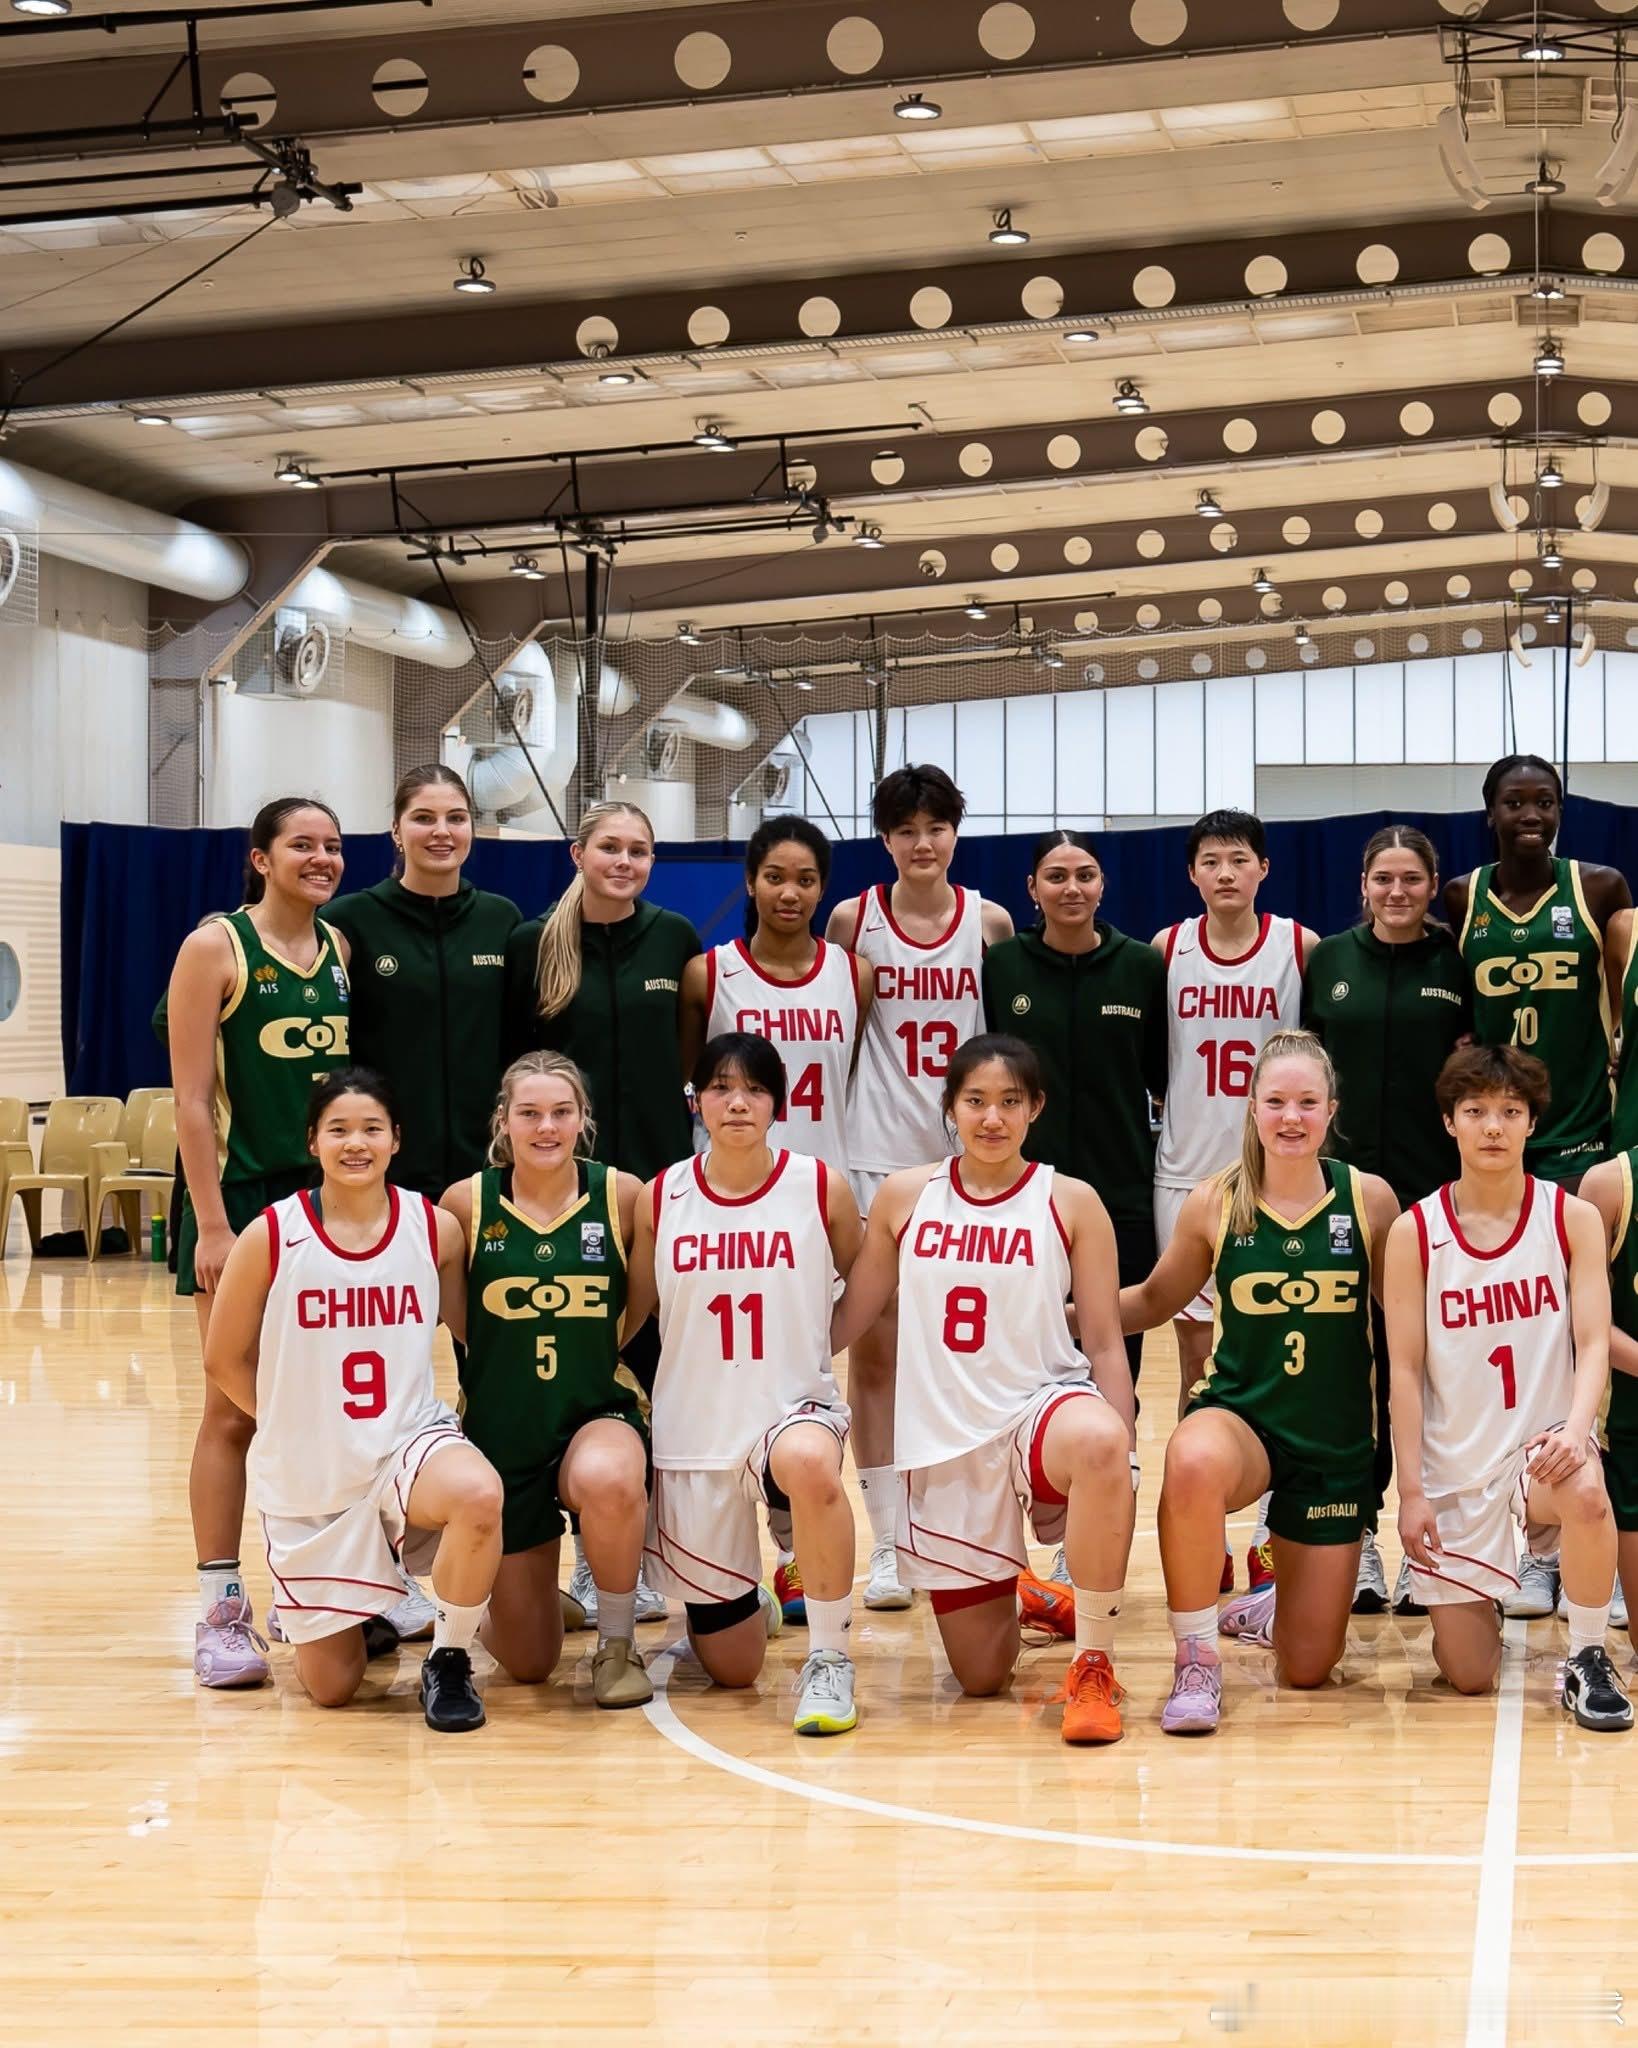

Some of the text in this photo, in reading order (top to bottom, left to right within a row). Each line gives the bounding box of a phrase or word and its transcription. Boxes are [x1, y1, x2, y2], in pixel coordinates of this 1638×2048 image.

[259, 983, 279, 994] AIS
[874, 966, 979, 1000] CHINA
[1178, 985, 1280, 1020] CHINA
[1421, 987, 1461, 1005] AUSTRALIA
[736, 1008, 844, 1043] CHINA
[1101, 1005, 1141, 1019] AUSTRALIA
[1510, 1006, 1538, 1046] 10
[896, 1020, 958, 1077] 13
[1196, 1040, 1256, 1097] 16
[484, 1240, 505, 1252] AIS
[673, 1231, 795, 1273] CHINA
[914, 1221, 1034, 1266] CHINA
[1234, 1236, 1254, 1248] AIS
[297, 1285, 423, 1329] CHINA
[943, 1286, 987, 1353] 8
[1440, 1274, 1560, 1328] CHINA
[707, 1293, 763, 1360] 11
[536, 1335, 558, 1380] 5
[1284, 1331, 1306, 1376] 3
[342, 1351, 387, 1419] 9
[1487, 1345, 1516, 1410] 1
[1306, 1503, 1358, 1520] AUSTRALIA
